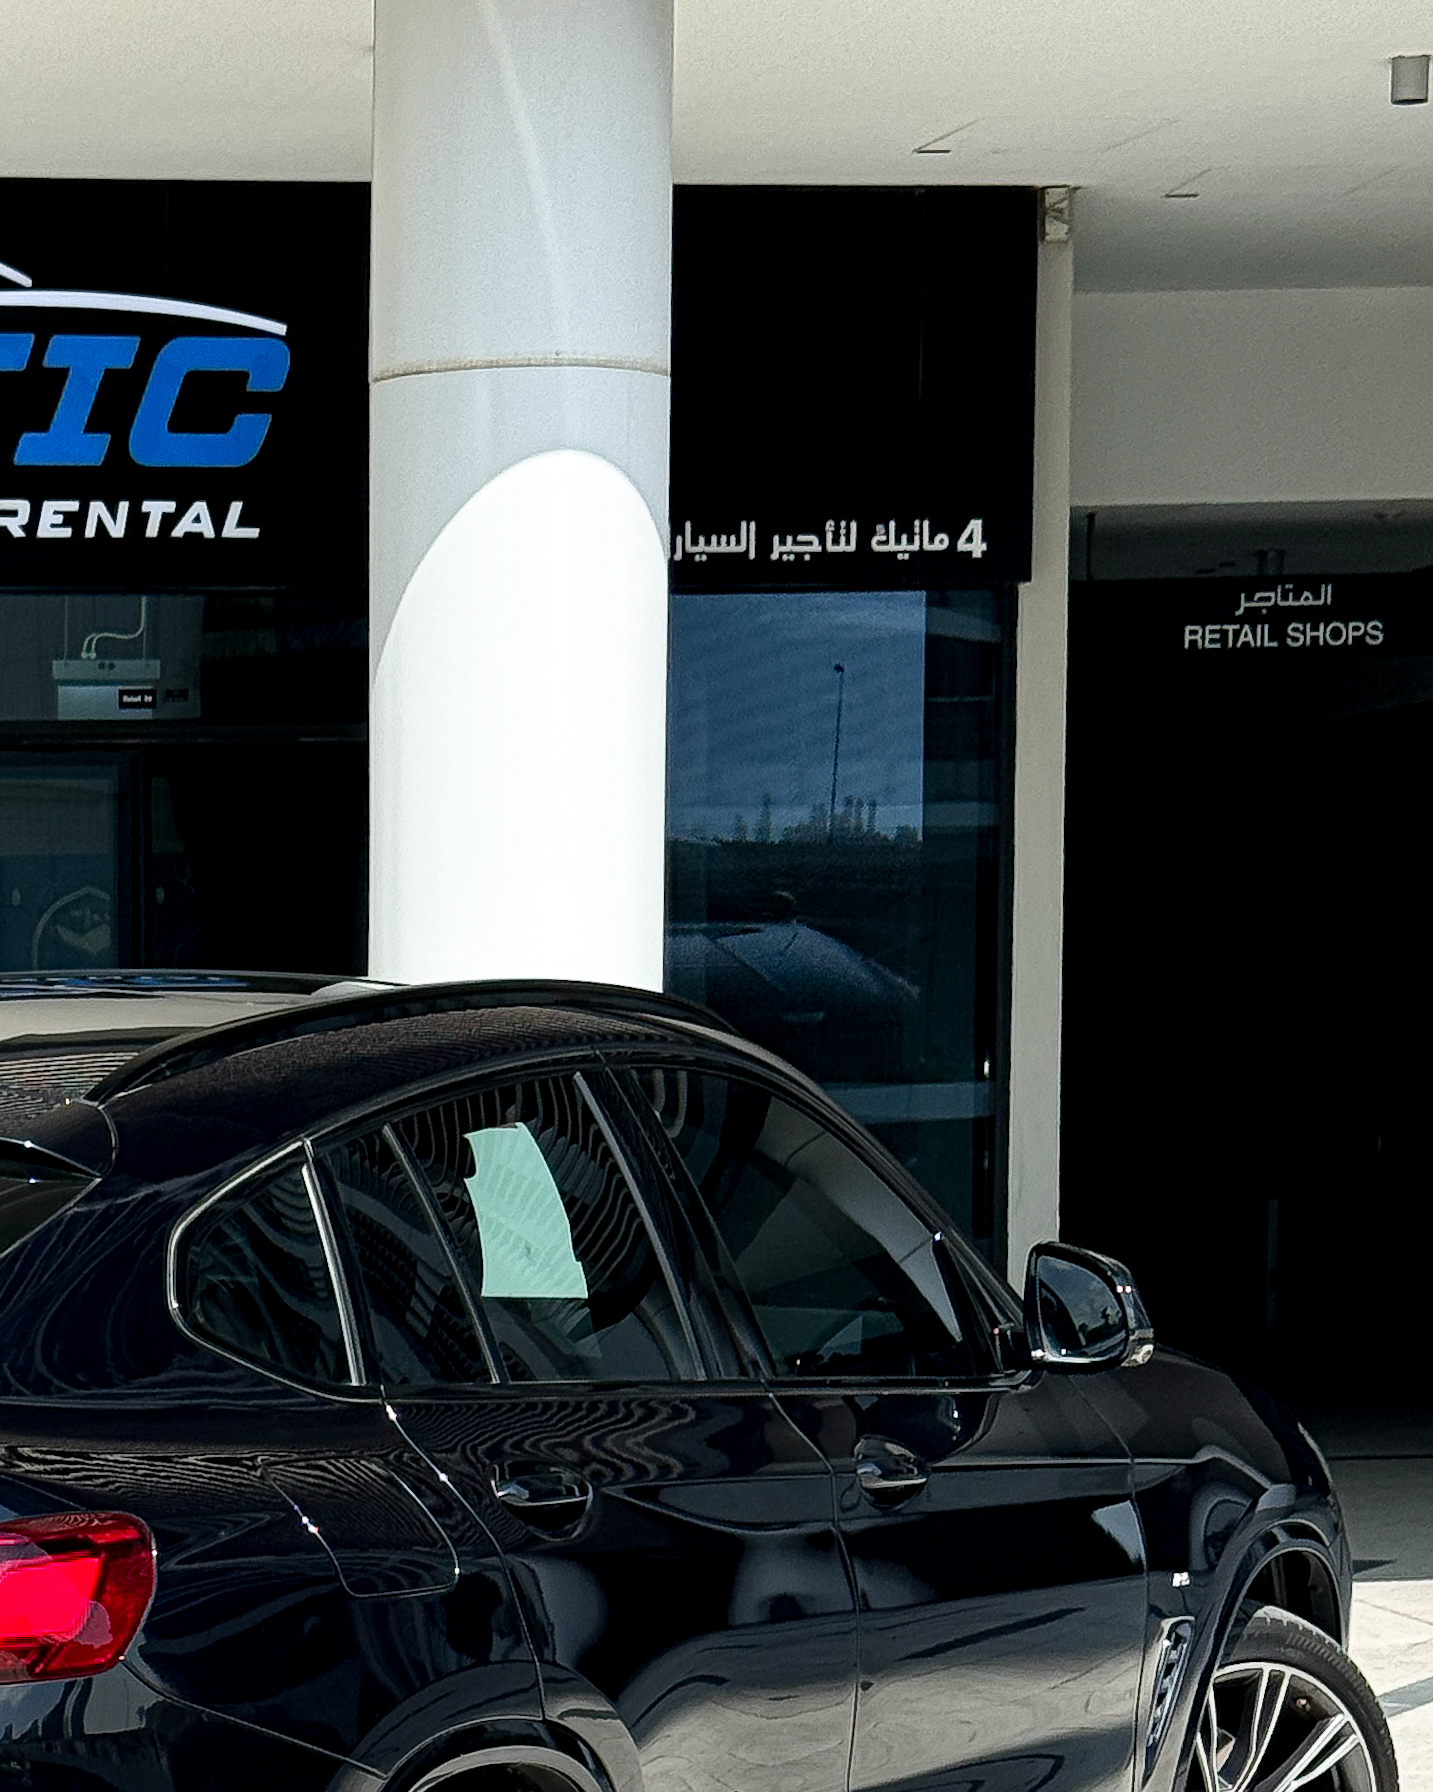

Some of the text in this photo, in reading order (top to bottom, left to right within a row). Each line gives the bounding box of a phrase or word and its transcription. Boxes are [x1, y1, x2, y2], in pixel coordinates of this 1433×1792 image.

[671, 519, 757, 563] السيار
[770, 519, 860, 563] لتأجير
[1234, 583, 1334, 617] المتاجر
[1183, 619, 1386, 651] RETAIL SHOPS
